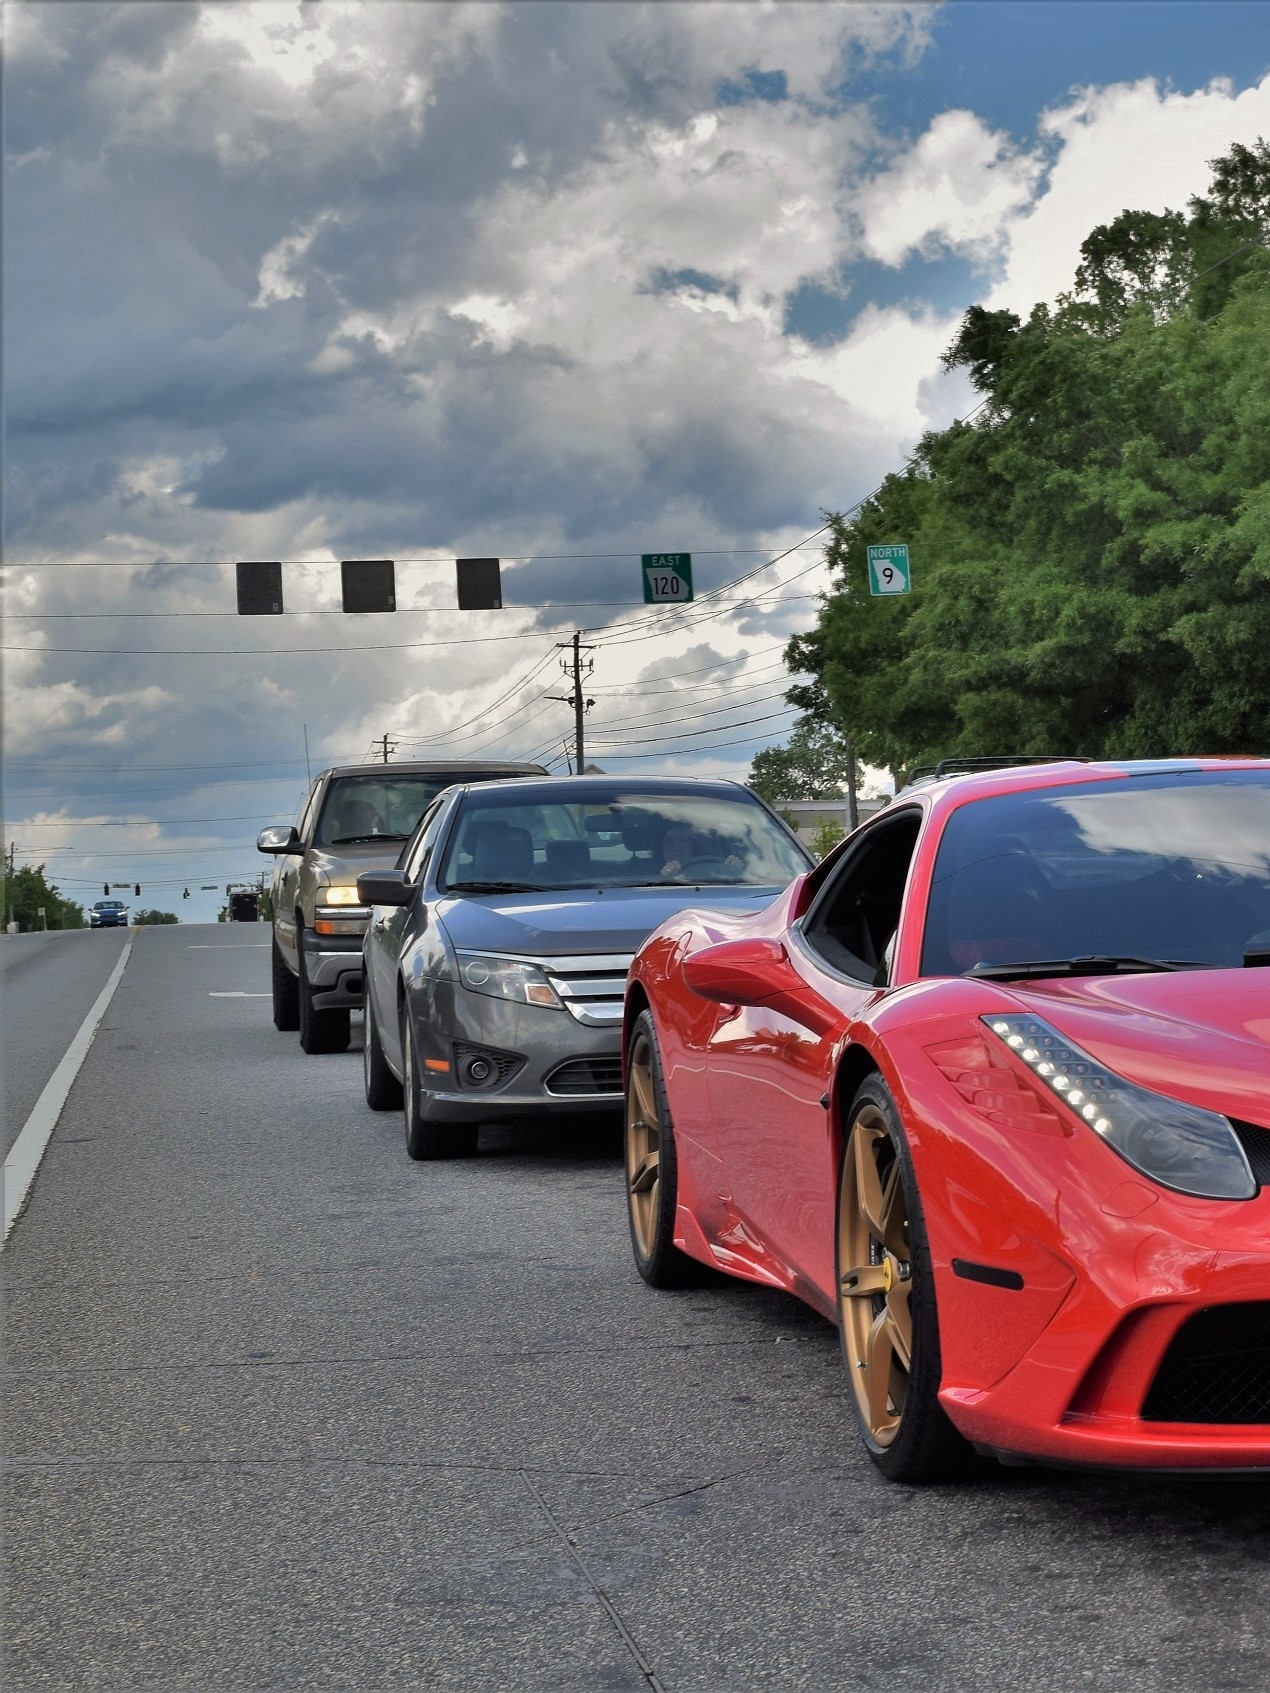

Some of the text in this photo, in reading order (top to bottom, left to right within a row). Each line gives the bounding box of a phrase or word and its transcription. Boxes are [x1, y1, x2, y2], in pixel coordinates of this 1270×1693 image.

[870, 547, 906, 558] NORTH
[652, 555, 680, 566] EAST
[882, 567, 894, 584] 9
[653, 576, 680, 595] 120
